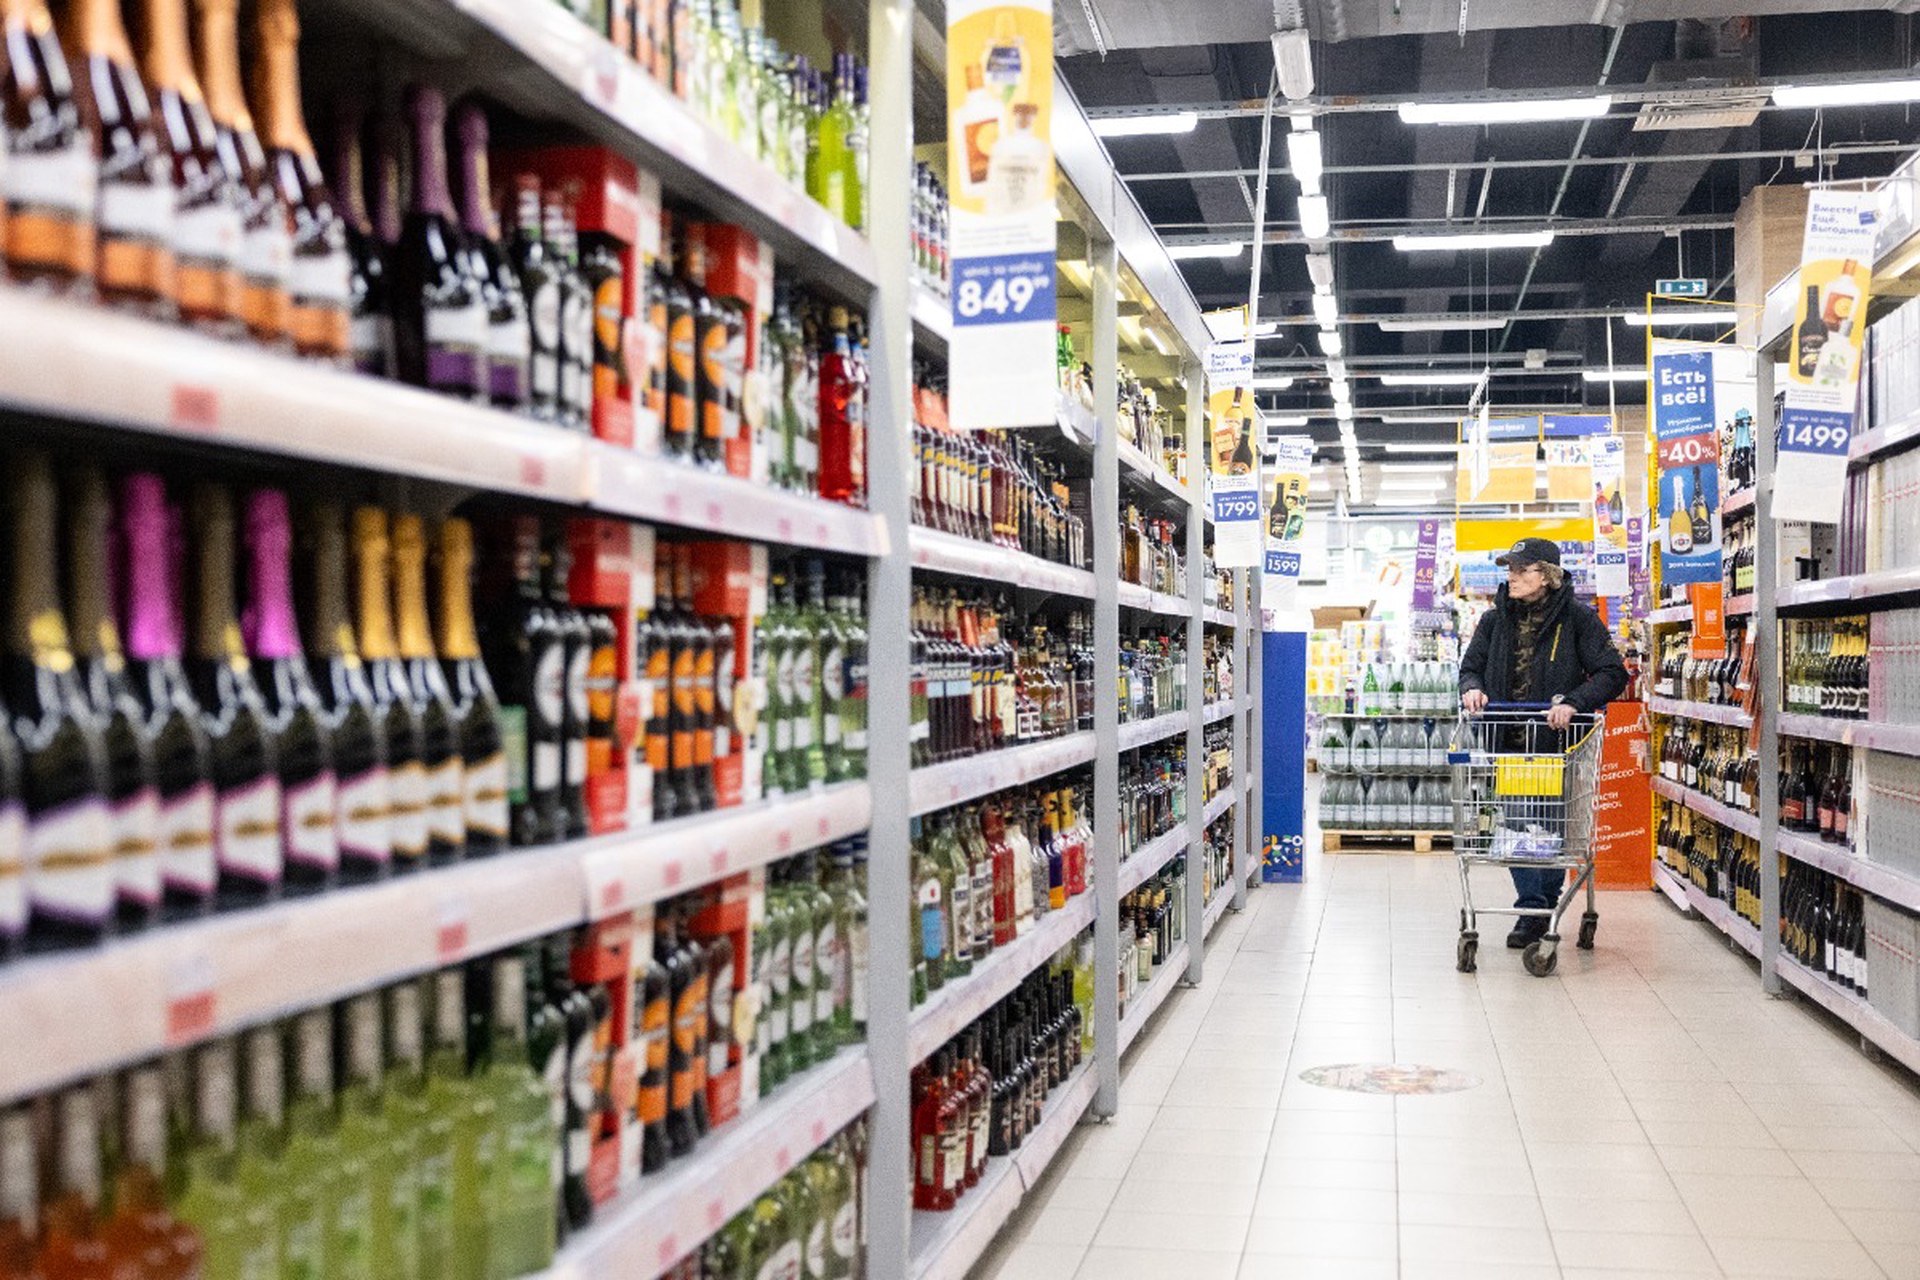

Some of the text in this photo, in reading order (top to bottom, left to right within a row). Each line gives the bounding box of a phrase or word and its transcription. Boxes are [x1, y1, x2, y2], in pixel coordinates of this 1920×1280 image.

[1661, 368, 1706, 386] Есть
[1661, 386, 1707, 406] всё!
[1787, 423, 1848, 449] 1499
[1217, 501, 1256, 517] 1799
[1268, 558, 1298, 573] 1599
